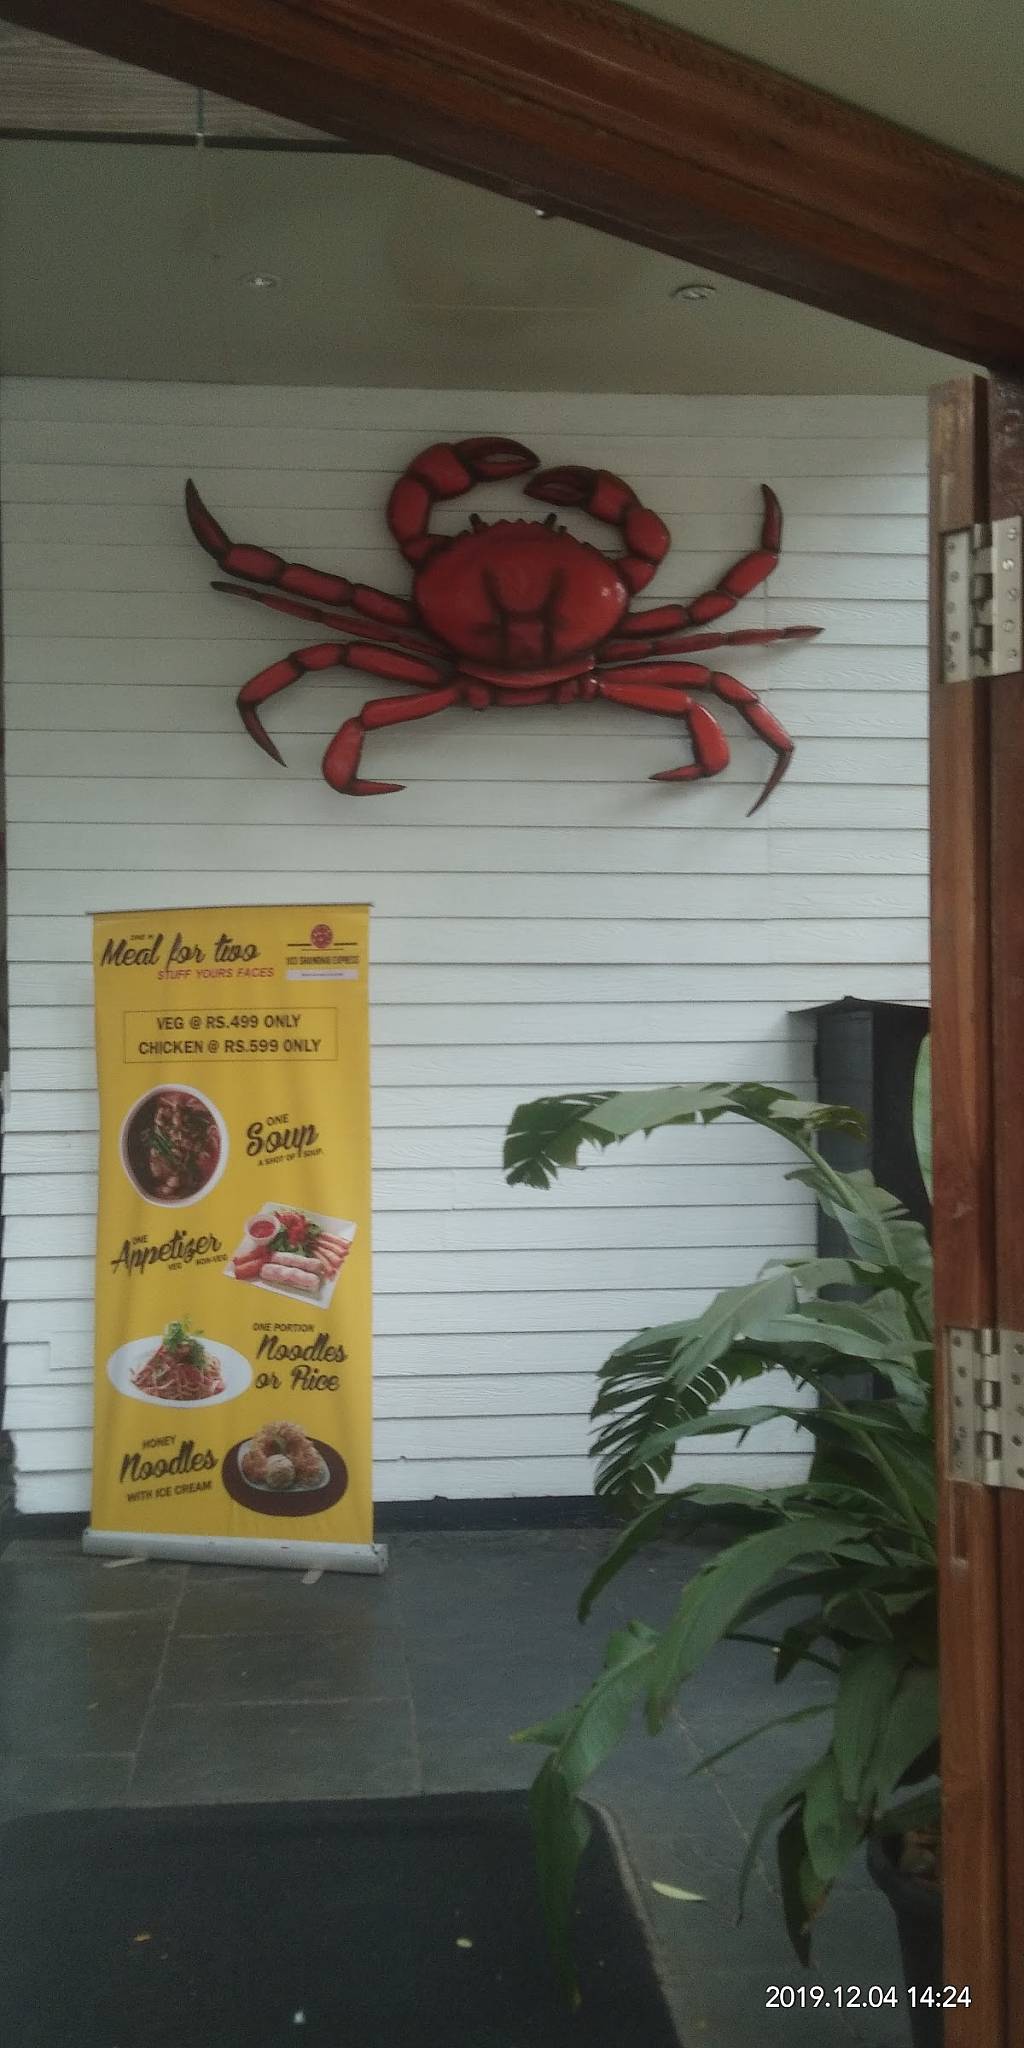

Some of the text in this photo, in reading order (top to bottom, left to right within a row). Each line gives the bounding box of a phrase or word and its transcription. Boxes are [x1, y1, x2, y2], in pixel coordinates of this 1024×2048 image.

[101, 931, 261, 972] Meal for two
[157, 967, 275, 981] STUFF YOURS FACES
[156, 1013, 302, 1030] VEG @ RS.499 ONLY
[138, 1038, 322, 1055] CHICKEN @ RS.599 ONLY
[266, 1113, 289, 1126] ONE
[246, 1121, 320, 1158] Soup
[132, 1234, 149, 1245] ONE
[111, 1229, 223, 1276] Appetizer
[168, 1262, 182, 1271] VEG
[252, 1322, 314, 1333] ONE PORTION
[256, 1332, 348, 1363] Noodles
[255, 1364, 341, 1392] or Rice
[142, 1434, 176, 1450] HONEY
[119, 1439, 218, 1484] Noodles
[127, 1480, 213, 1502] WITH ICE CREAM
